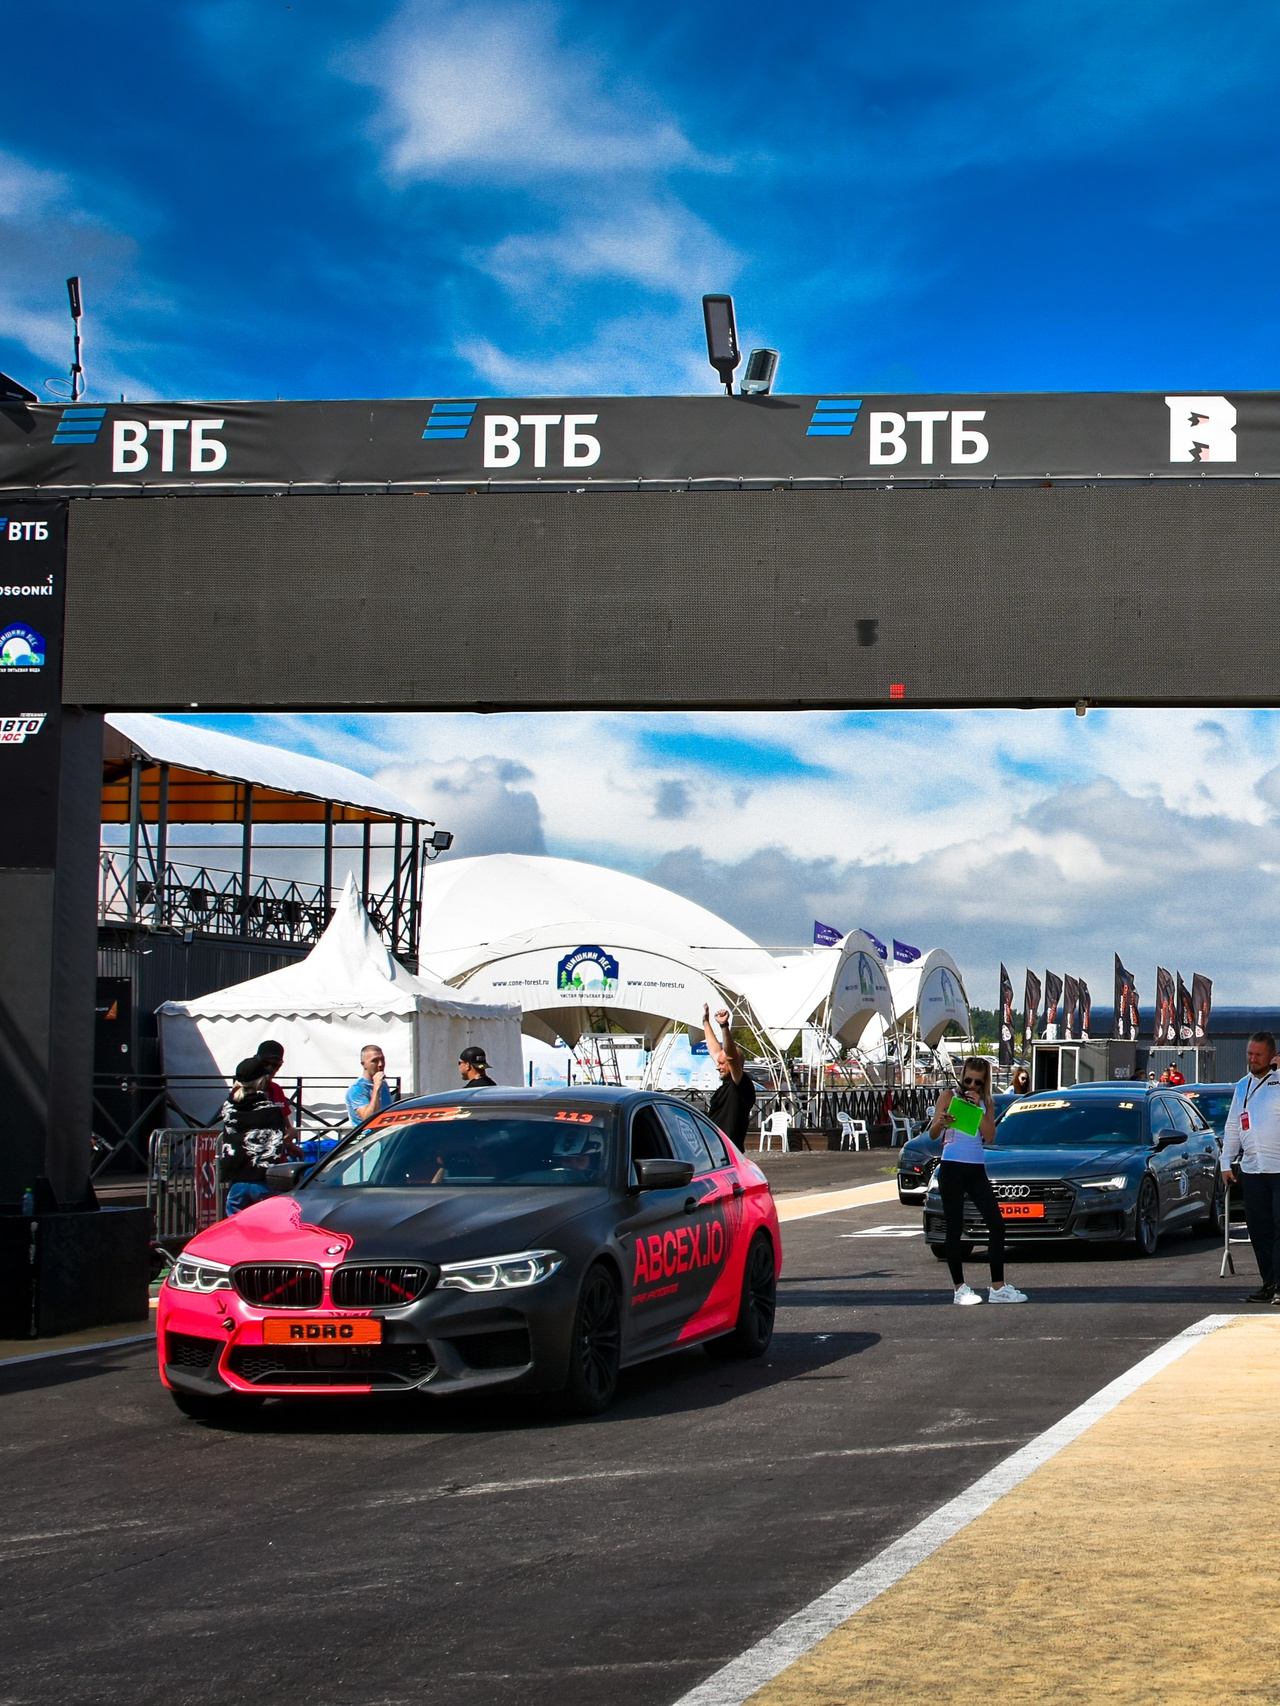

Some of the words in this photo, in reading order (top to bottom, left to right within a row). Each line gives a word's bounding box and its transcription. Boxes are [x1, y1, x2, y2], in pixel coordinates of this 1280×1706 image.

[113, 419, 228, 473] ВТБ
[483, 414, 601, 468] ВТБ
[869, 411, 989, 465] ВТБ
[8, 521, 49, 541] ВТБ
[0, 733, 21, 741] ЮС
[565, 951, 598, 971] ШИШКИН
[598, 957, 612, 971] ЛЕС
[492, 979, 549, 987] www.cone-forest.ru
[627, 979, 685, 989] www.cone-forest.ru
[378, 1110, 446, 1124] RDRC
[554, 1111, 594, 1124] 113
[633, 1220, 724, 1287] ABCEX.IO
[290, 1325, 354, 1339] RDRC
